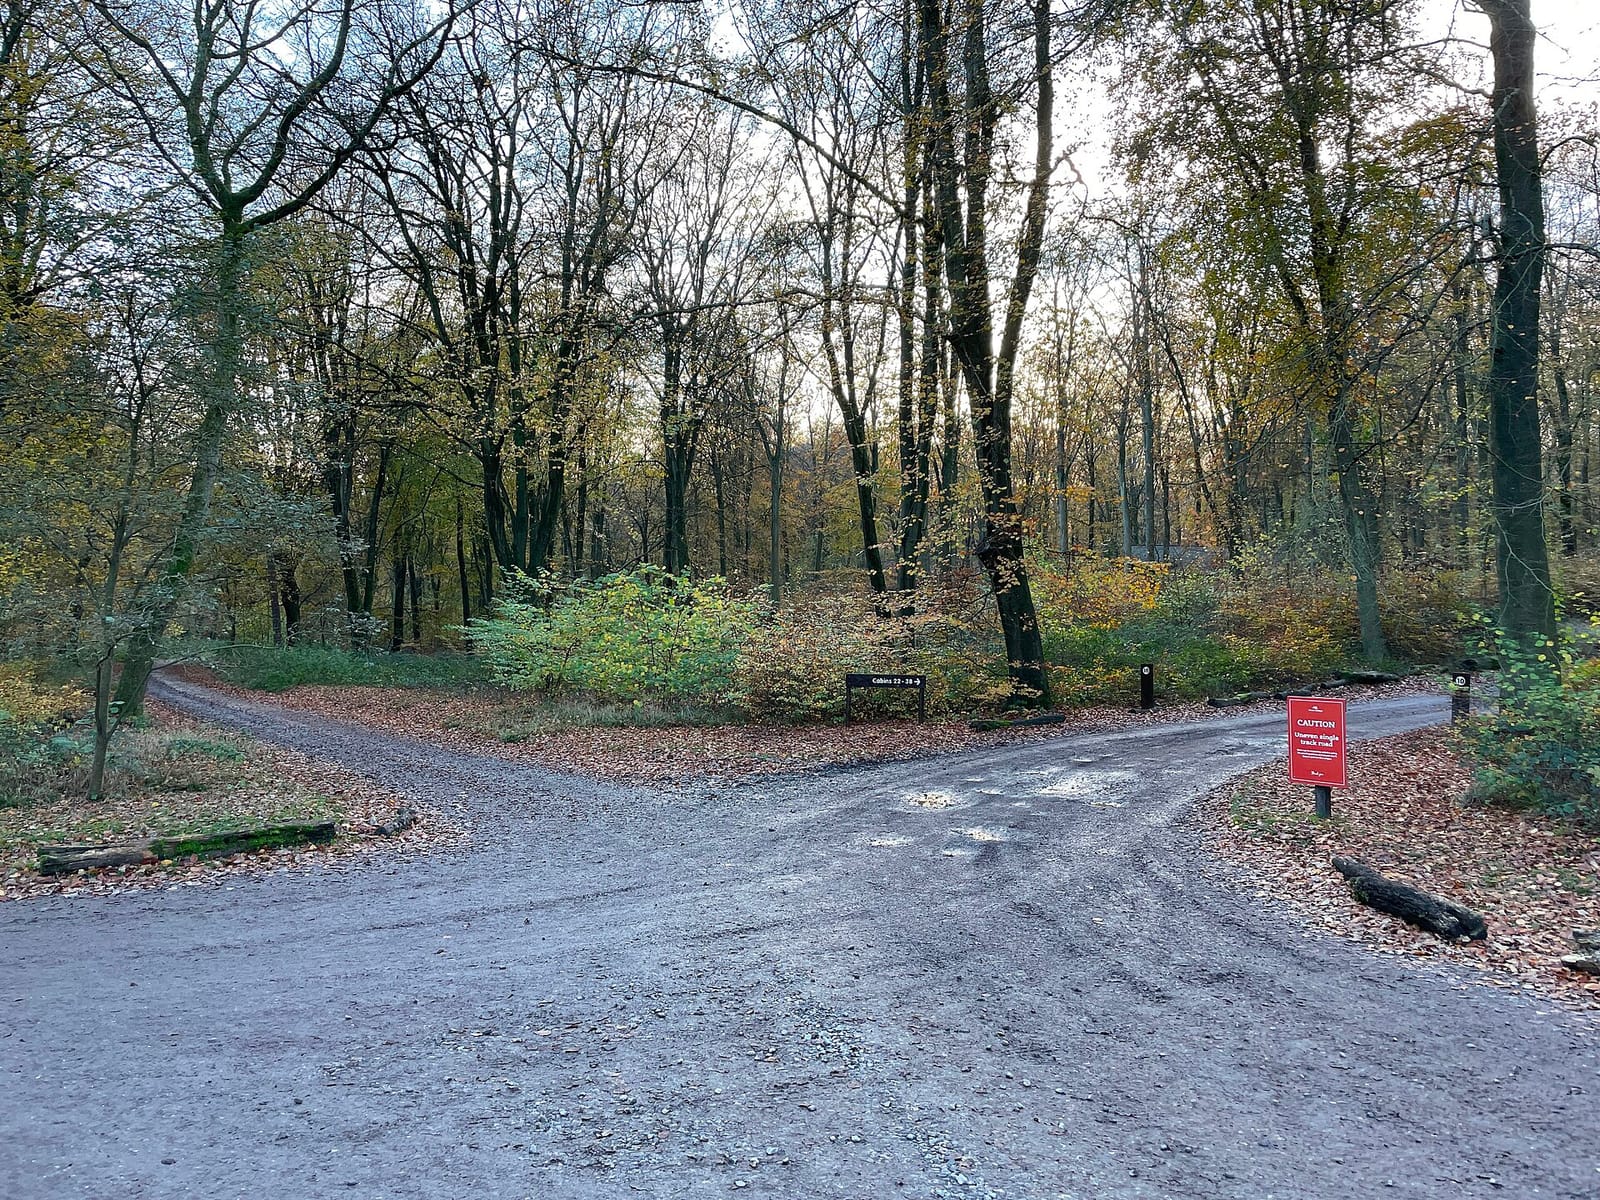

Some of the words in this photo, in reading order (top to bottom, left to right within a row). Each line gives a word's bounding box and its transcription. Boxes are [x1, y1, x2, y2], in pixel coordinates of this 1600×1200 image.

[1297, 719, 1336, 729] CAUTION
[1294, 731, 1318, 739] Uneven
[1319, 733, 1339, 741] single
